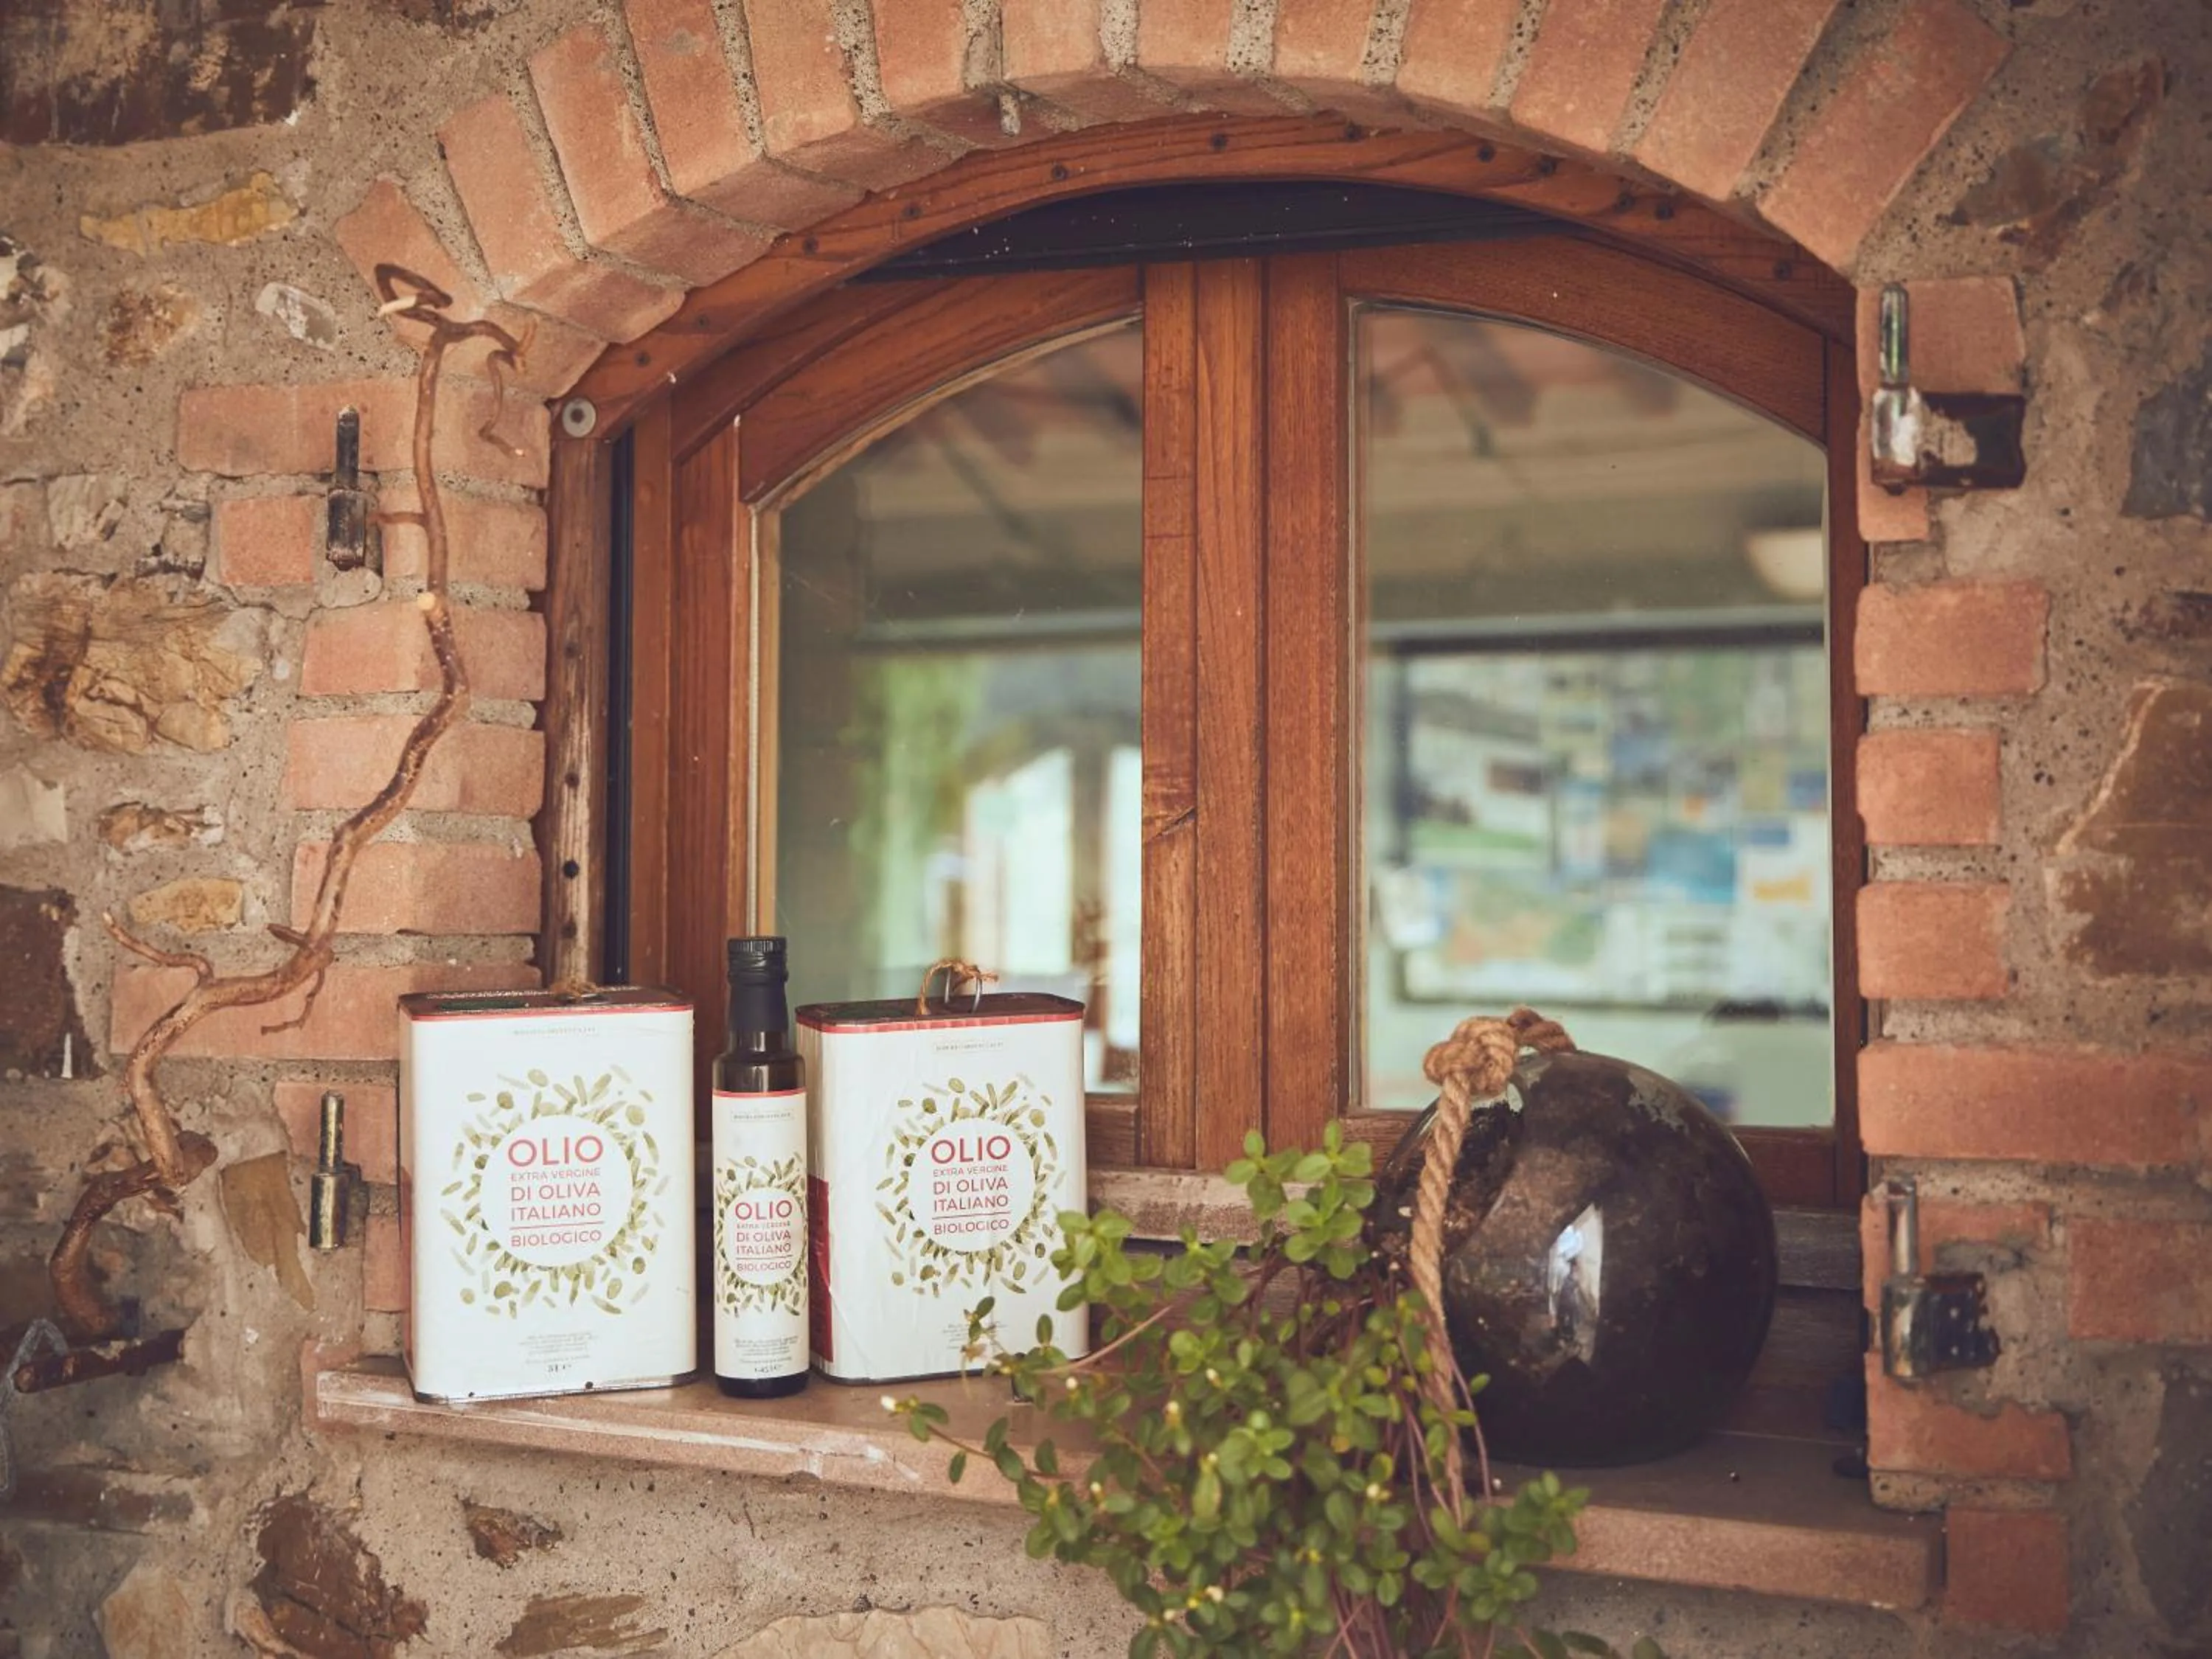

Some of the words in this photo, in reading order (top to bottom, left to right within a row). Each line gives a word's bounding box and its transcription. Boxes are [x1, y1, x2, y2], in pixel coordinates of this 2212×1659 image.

[507, 1135, 604, 1167] OLIO
[931, 1135, 1011, 1164] OLIO
[510, 1172, 548, 1182] EXTRA
[551, 1168, 602, 1179] VERGINE
[933, 1168, 964, 1178] EXTRA
[967, 1164, 1009, 1175] VERGINE
[511, 1186, 531, 1202] DI
[539, 1181, 601, 1200] OLIVA
[933, 1181, 950, 1194] DI
[956, 1177, 1008, 1192] OLIVA
[734, 1200, 793, 1220] OLIO
[933, 1194, 1009, 1212] ITALIANO
[511, 1203, 602, 1222] ITALIANO
[933, 1219, 1009, 1235] BIOLOGICO
[511, 1230, 602, 1248] BIOLOGICO
[737, 1232, 749, 1242] DI
[753, 1230, 791, 1242] OLIVA
[737, 1242, 791, 1254] ITALIANO
[737, 1260, 792, 1272] BIOLOGICO
